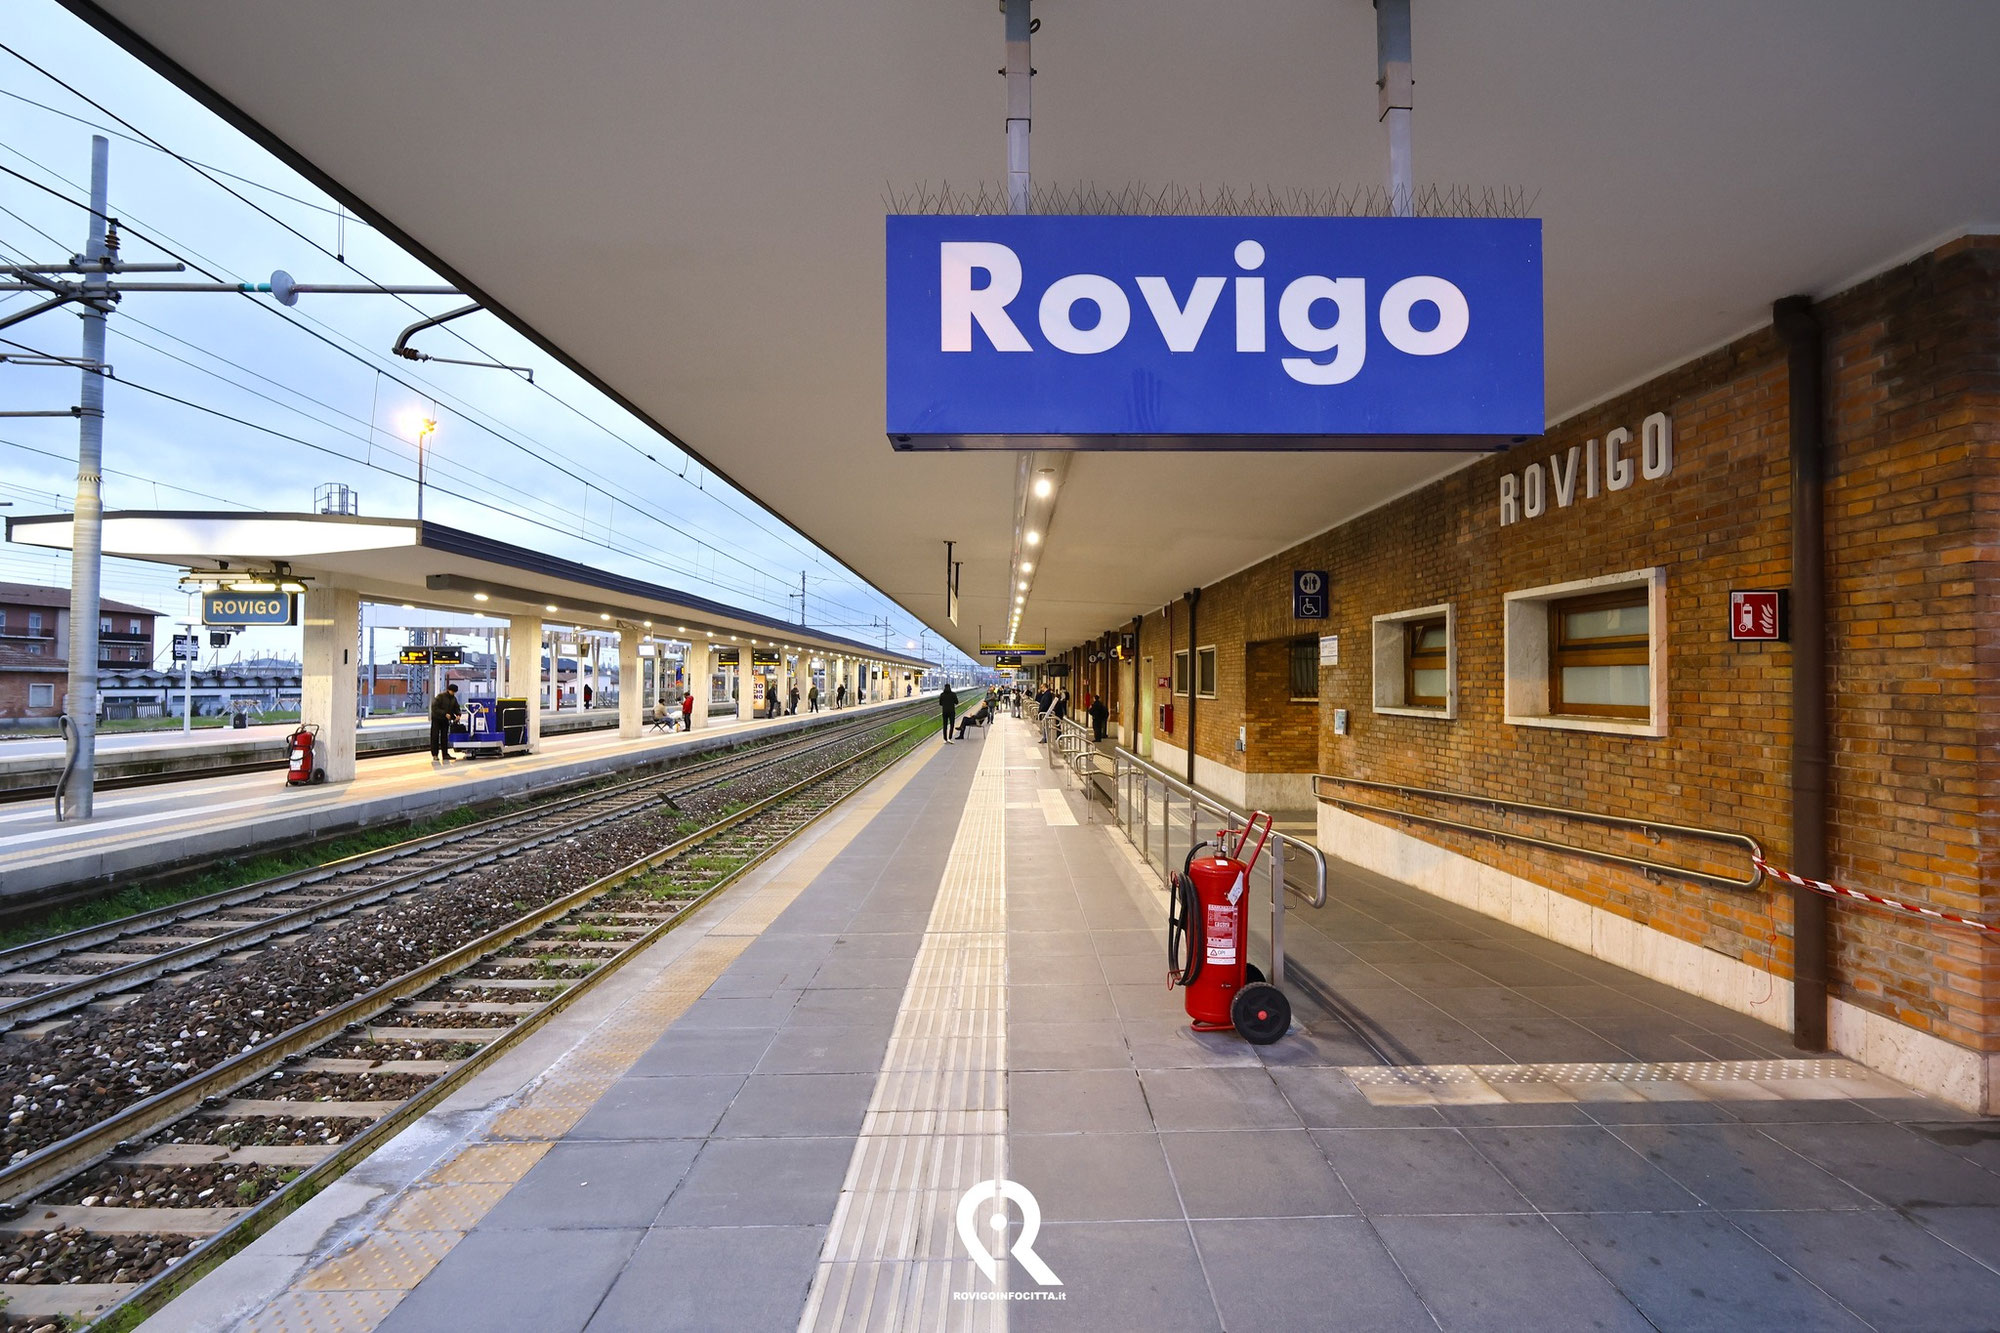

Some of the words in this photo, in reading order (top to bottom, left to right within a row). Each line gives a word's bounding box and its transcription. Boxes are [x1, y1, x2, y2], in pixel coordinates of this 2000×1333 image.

[941, 240, 1470, 385] Rovigo
[1500, 411, 1673, 527] ROVIGO
[212, 600, 280, 615] ROVIGO
[1123, 634, 1132, 648] T
